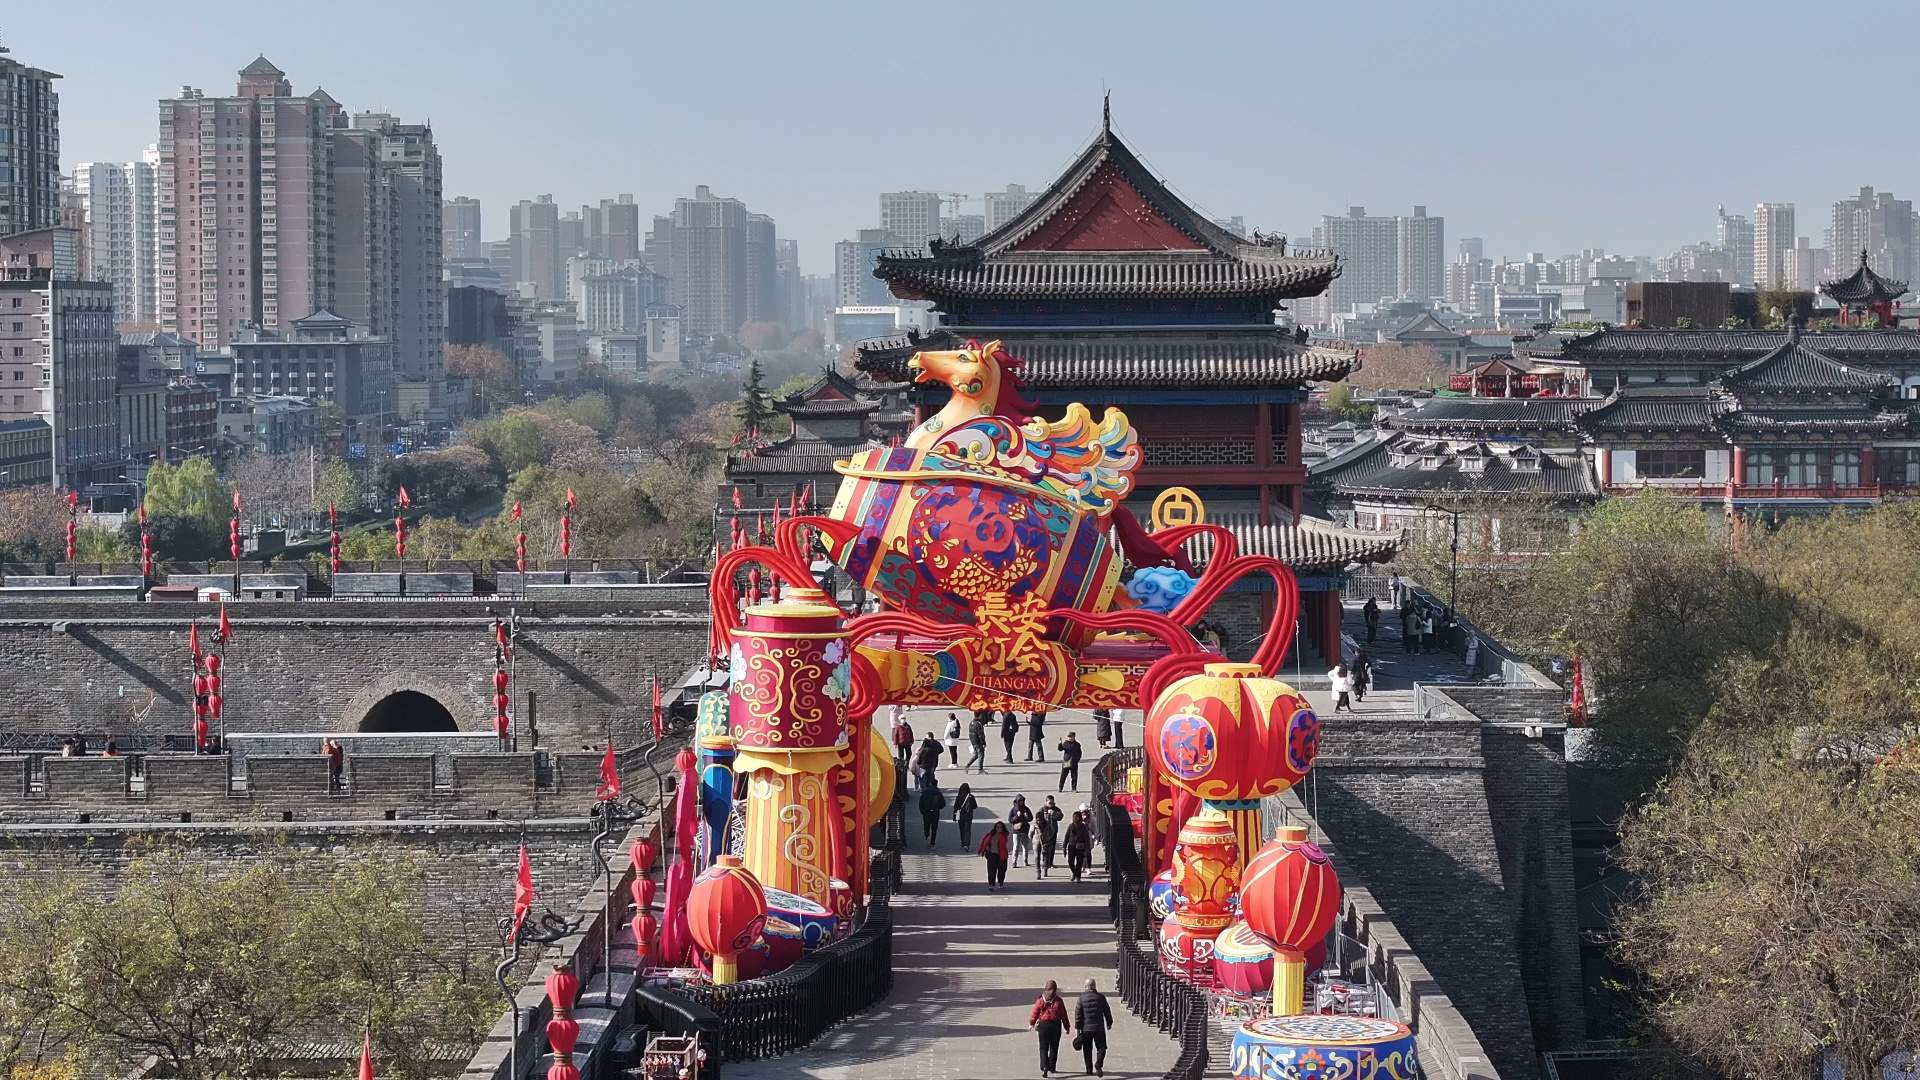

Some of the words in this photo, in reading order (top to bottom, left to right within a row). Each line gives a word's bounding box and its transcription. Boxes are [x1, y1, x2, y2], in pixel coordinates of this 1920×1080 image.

[975, 591, 1047, 637] 長安
[974, 632, 1050, 672] 灯会
[973, 676, 1047, 690] CHANG'AN
